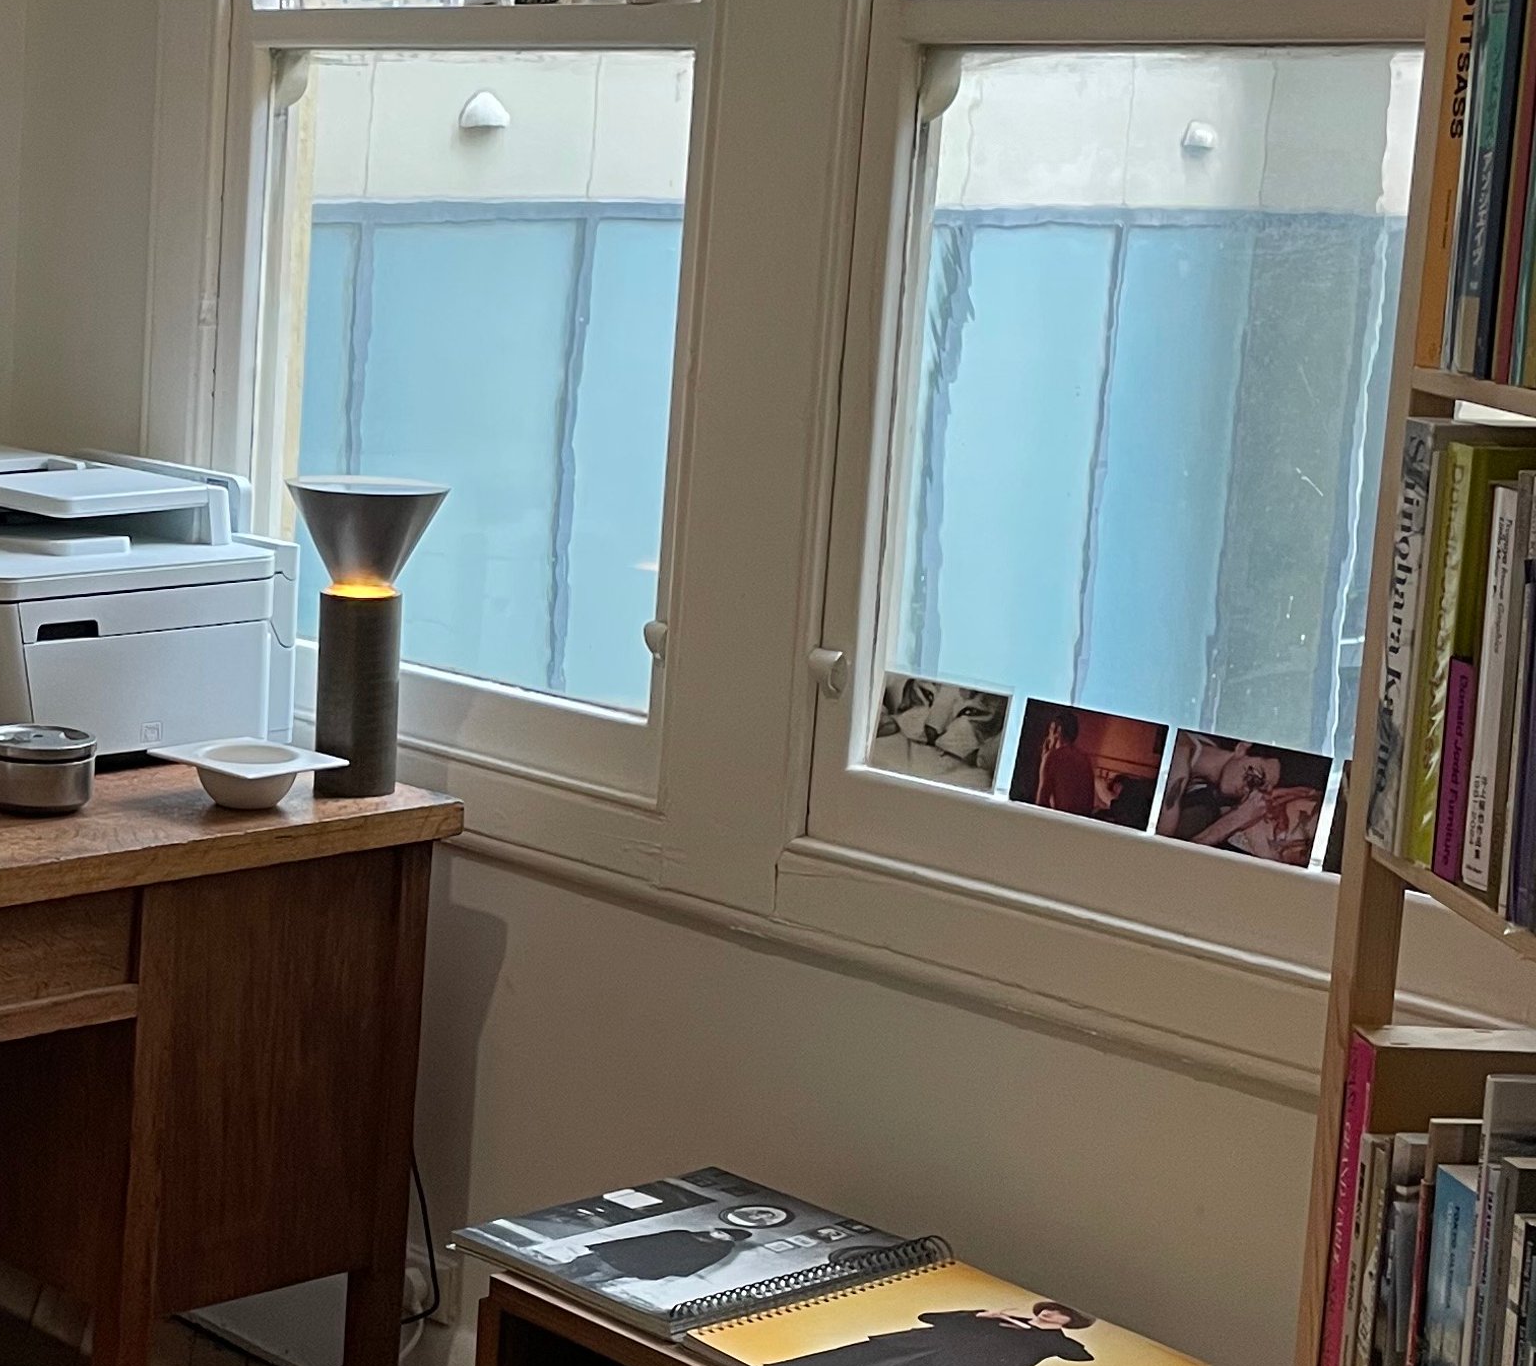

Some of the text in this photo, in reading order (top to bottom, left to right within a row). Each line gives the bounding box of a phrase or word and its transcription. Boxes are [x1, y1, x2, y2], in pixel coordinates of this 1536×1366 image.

[1440, 673, 1470, 867] Donald Judd Furniture
